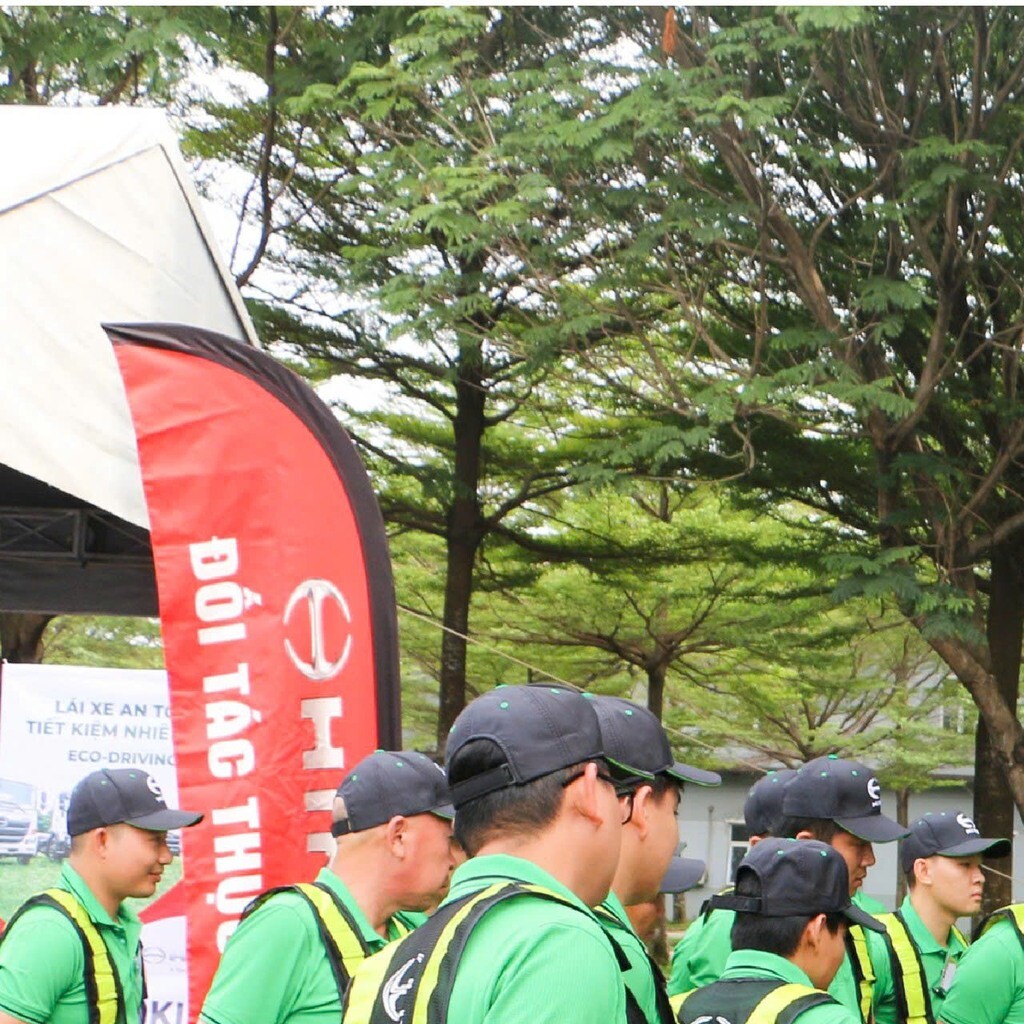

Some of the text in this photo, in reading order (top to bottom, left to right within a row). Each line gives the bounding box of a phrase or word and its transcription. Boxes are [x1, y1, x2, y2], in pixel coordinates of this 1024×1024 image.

[189, 535, 263, 646] ĐỐI
[26, 715, 65, 736] TIẾT
[55, 697, 84, 715] LÁI
[90, 702, 114, 716] XE
[120, 703, 147, 718] AN
[202, 661, 263, 779] TÁC
